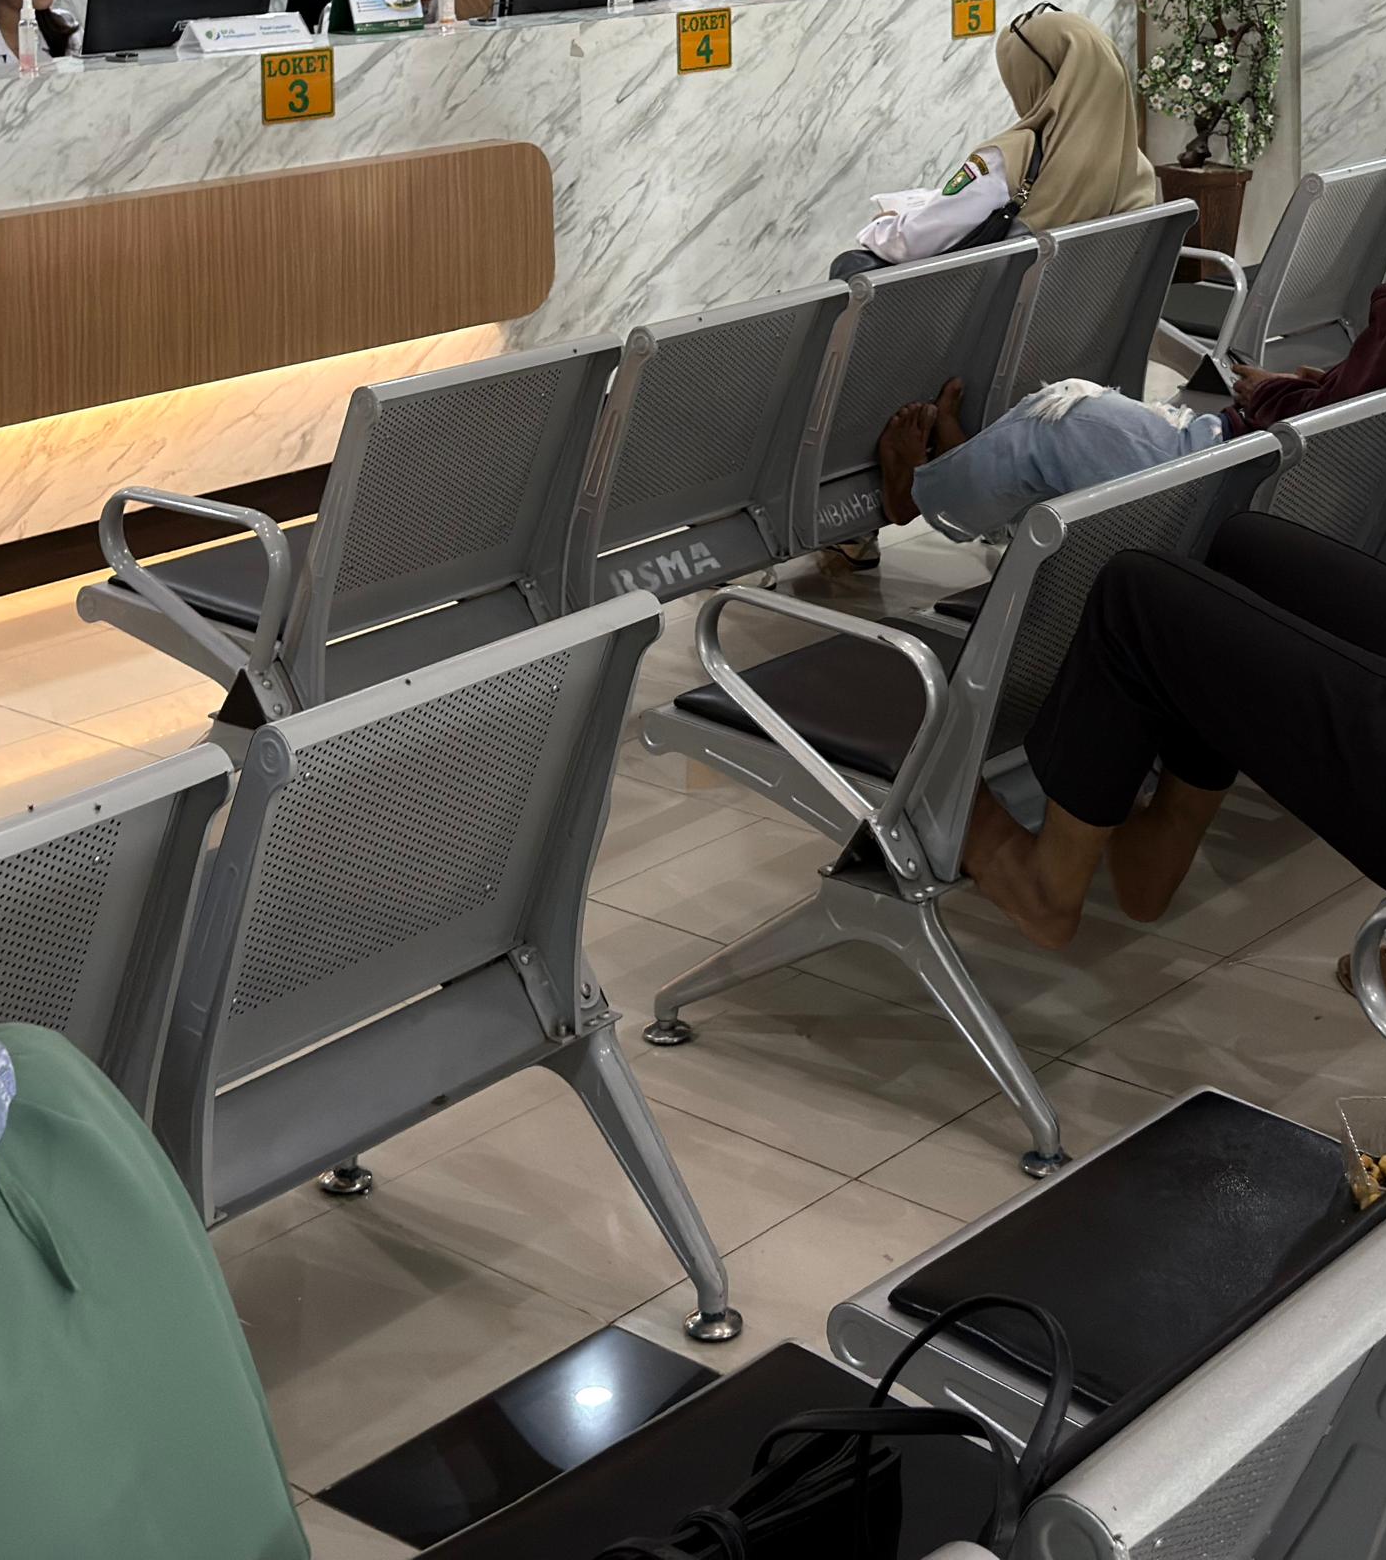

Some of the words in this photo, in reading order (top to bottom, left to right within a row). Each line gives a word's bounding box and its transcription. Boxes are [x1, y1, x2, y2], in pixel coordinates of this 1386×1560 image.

[681, 12, 726, 32] LOKET
[966, 5, 982, 31] 5
[695, 34, 714, 65] 4
[266, 55, 328, 77] LOKET
[288, 79, 310, 113] 3
[608, 541, 722, 596] RSMA
